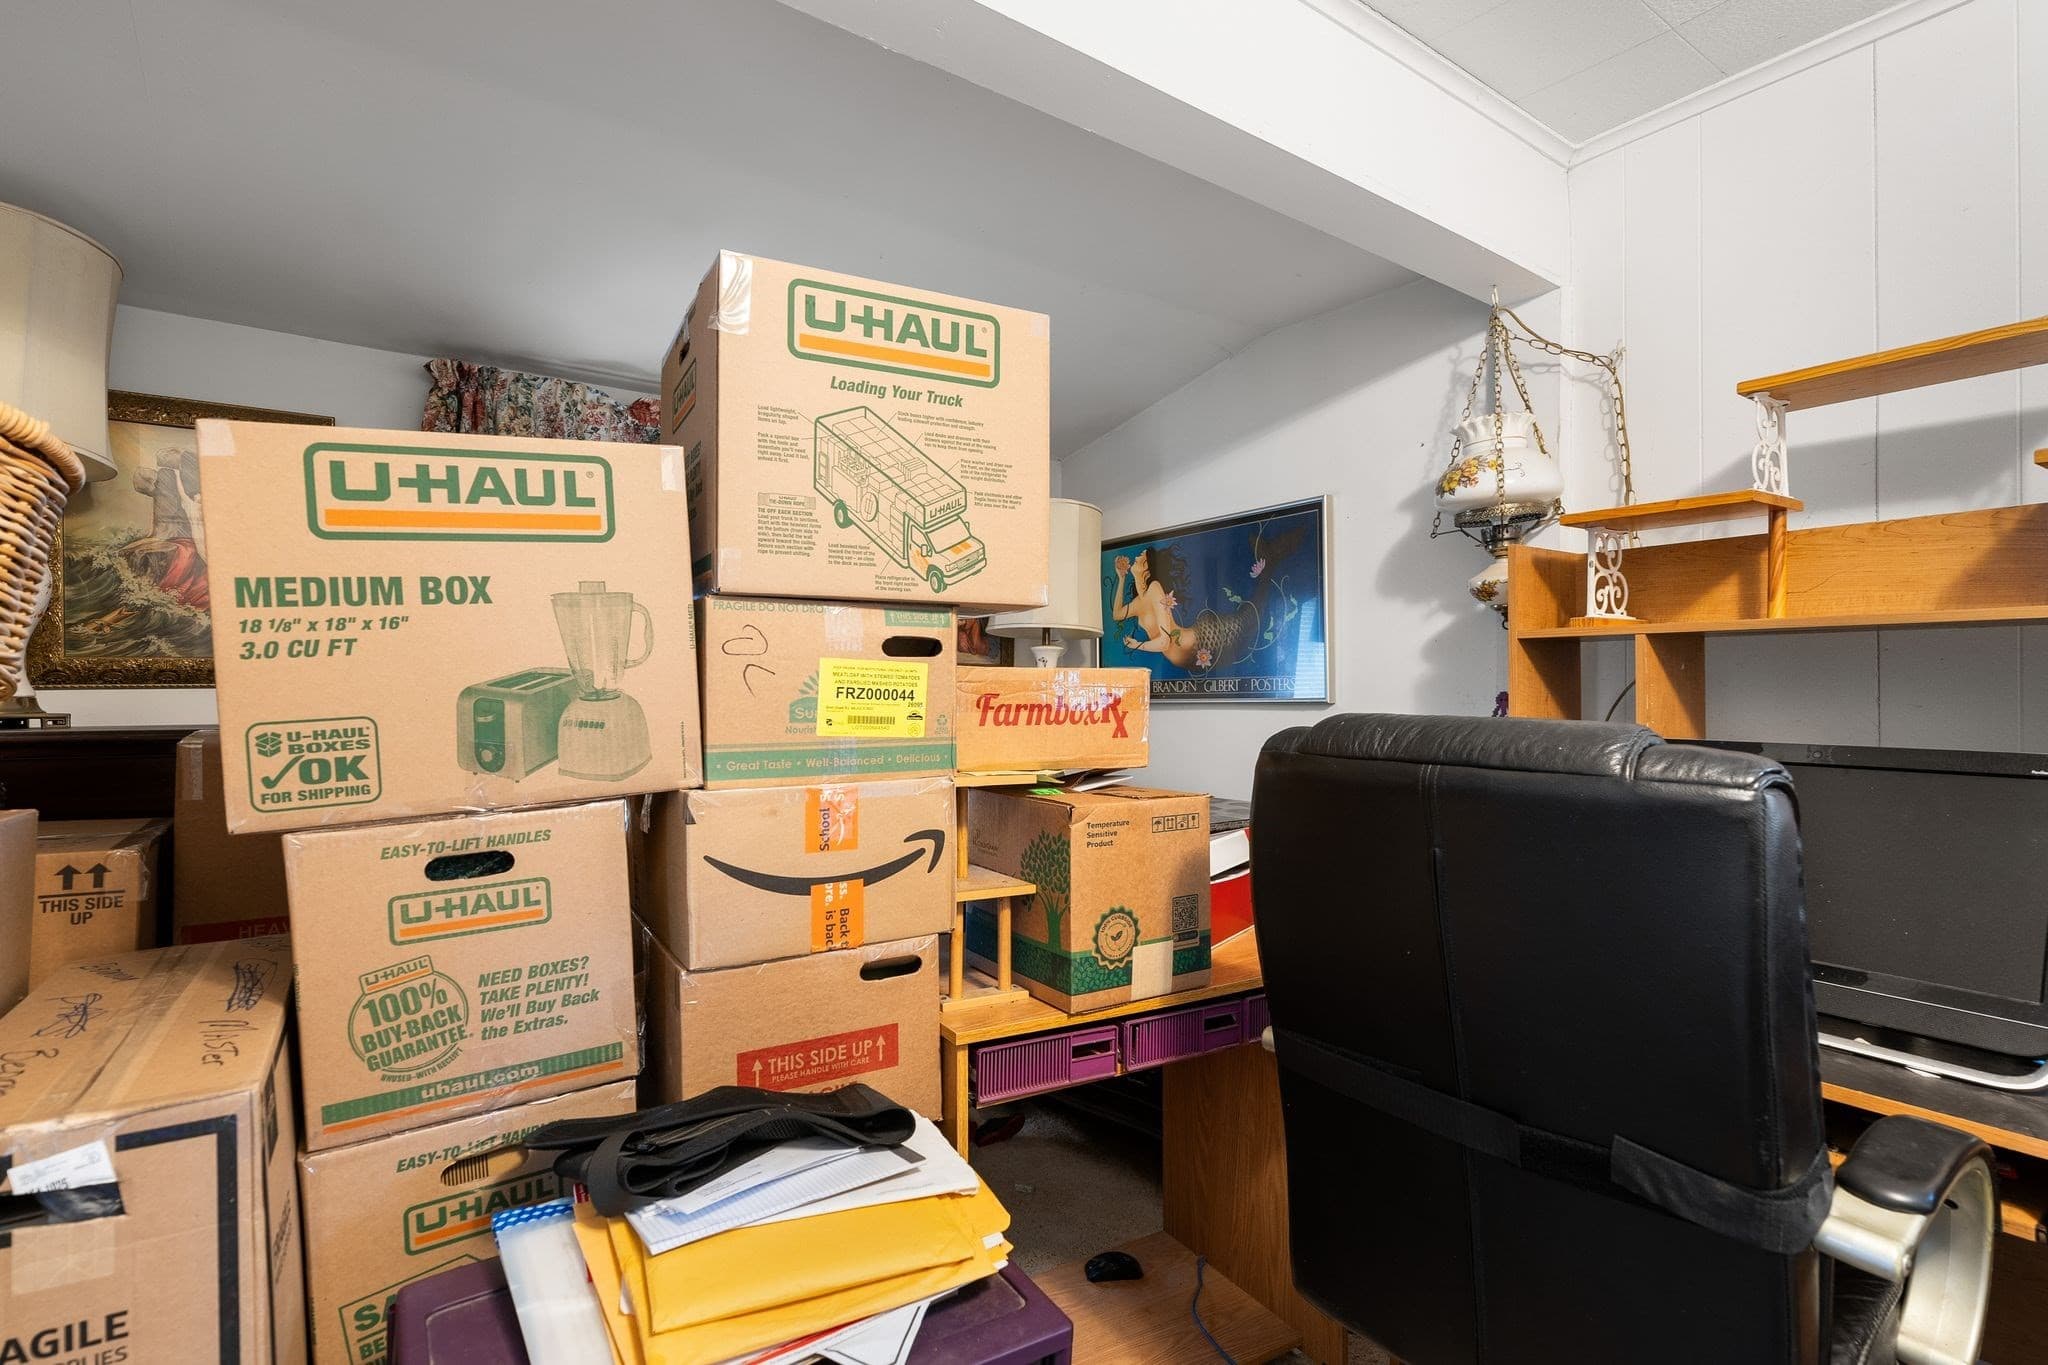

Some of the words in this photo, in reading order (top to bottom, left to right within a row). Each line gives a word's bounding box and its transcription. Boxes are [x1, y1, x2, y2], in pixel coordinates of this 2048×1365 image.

[830, 375, 887, 400] Loading
[892, 384, 923, 404] Your
[926, 390, 963, 408] Truck
[234, 576, 404, 609] MEDIUM
[420, 575, 493, 606] BOX
[713, 601, 756, 611] FRAGILE
[759, 602, 776, 612] DO
[778, 603, 798, 613] NOT
[238, 617, 263, 634] 18
[306, 620, 319, 632] x
[326, 615, 357, 633] 18"
[362, 619, 375, 631] x
[381, 615, 409, 632] 16"
[239, 640, 279, 661] 3.0
[287, 639, 320, 659] CU
[328, 638, 357, 657] FT
[836, 687, 916, 702] FRZ000044
[1152, 680, 1197, 694] BRANDEN
[1203, 679, 1241, 692] GILBERT
[1250, 678, 1296, 691] POSTERS
[287, 739, 372, 755] BOXES
[299, 753, 371, 783] OK
[726, 761, 760, 772] Great
[763, 759, 792, 770] Taste
[806, 755, 884, 768] Well-Balanced
[896, 753, 941, 764] Delicious
[260, 788, 292, 805] FOR
[296, 783, 372, 803] SHIPPING
[819, 808, 830, 851] School
[1087, 820, 1130, 831] Temperature
[1087, 829, 1118, 839] Sensitive
[380, 836, 483, 860] EASY-TO-LIFT
[486, 829, 551, 849] HANDLES
[1087, 839, 1114, 849] Product
[39, 899, 79, 914] THIS
[85, 896, 124, 910] SIDE
[70, 911, 94, 925] UP
[826, 910, 836, 920] is
[826, 923, 836, 949] bac
[840, 908, 850, 938] Back
[478, 967, 522, 988] NEED
[528, 956, 590, 978] BOXES?
[479, 988, 520, 1006] TAKE
[525, 974, 589, 998] PLENTY!
[362, 979, 447, 1028] 100%
[481, 1003, 520, 1023] We'll
[526, 999, 555, 1015] Buy
[561, 988, 600, 1007] Back
[360, 1004, 463, 1054] BUY-BACK
[481, 1025, 508, 1041] the
[514, 1014, 568, 1034] Extras.
[768, 1053, 804, 1074] THIS
[810, 1045, 847, 1066] SIDE
[852, 1040, 873, 1057] UP
[772, 1072, 799, 1083] PLEASE
[799, 1066, 830, 1078] HANDLE
[831, 1061, 849, 1071] WITH
[850, 1056, 870, 1066] CARE
[421, 1064, 543, 1100] uhaul.com
